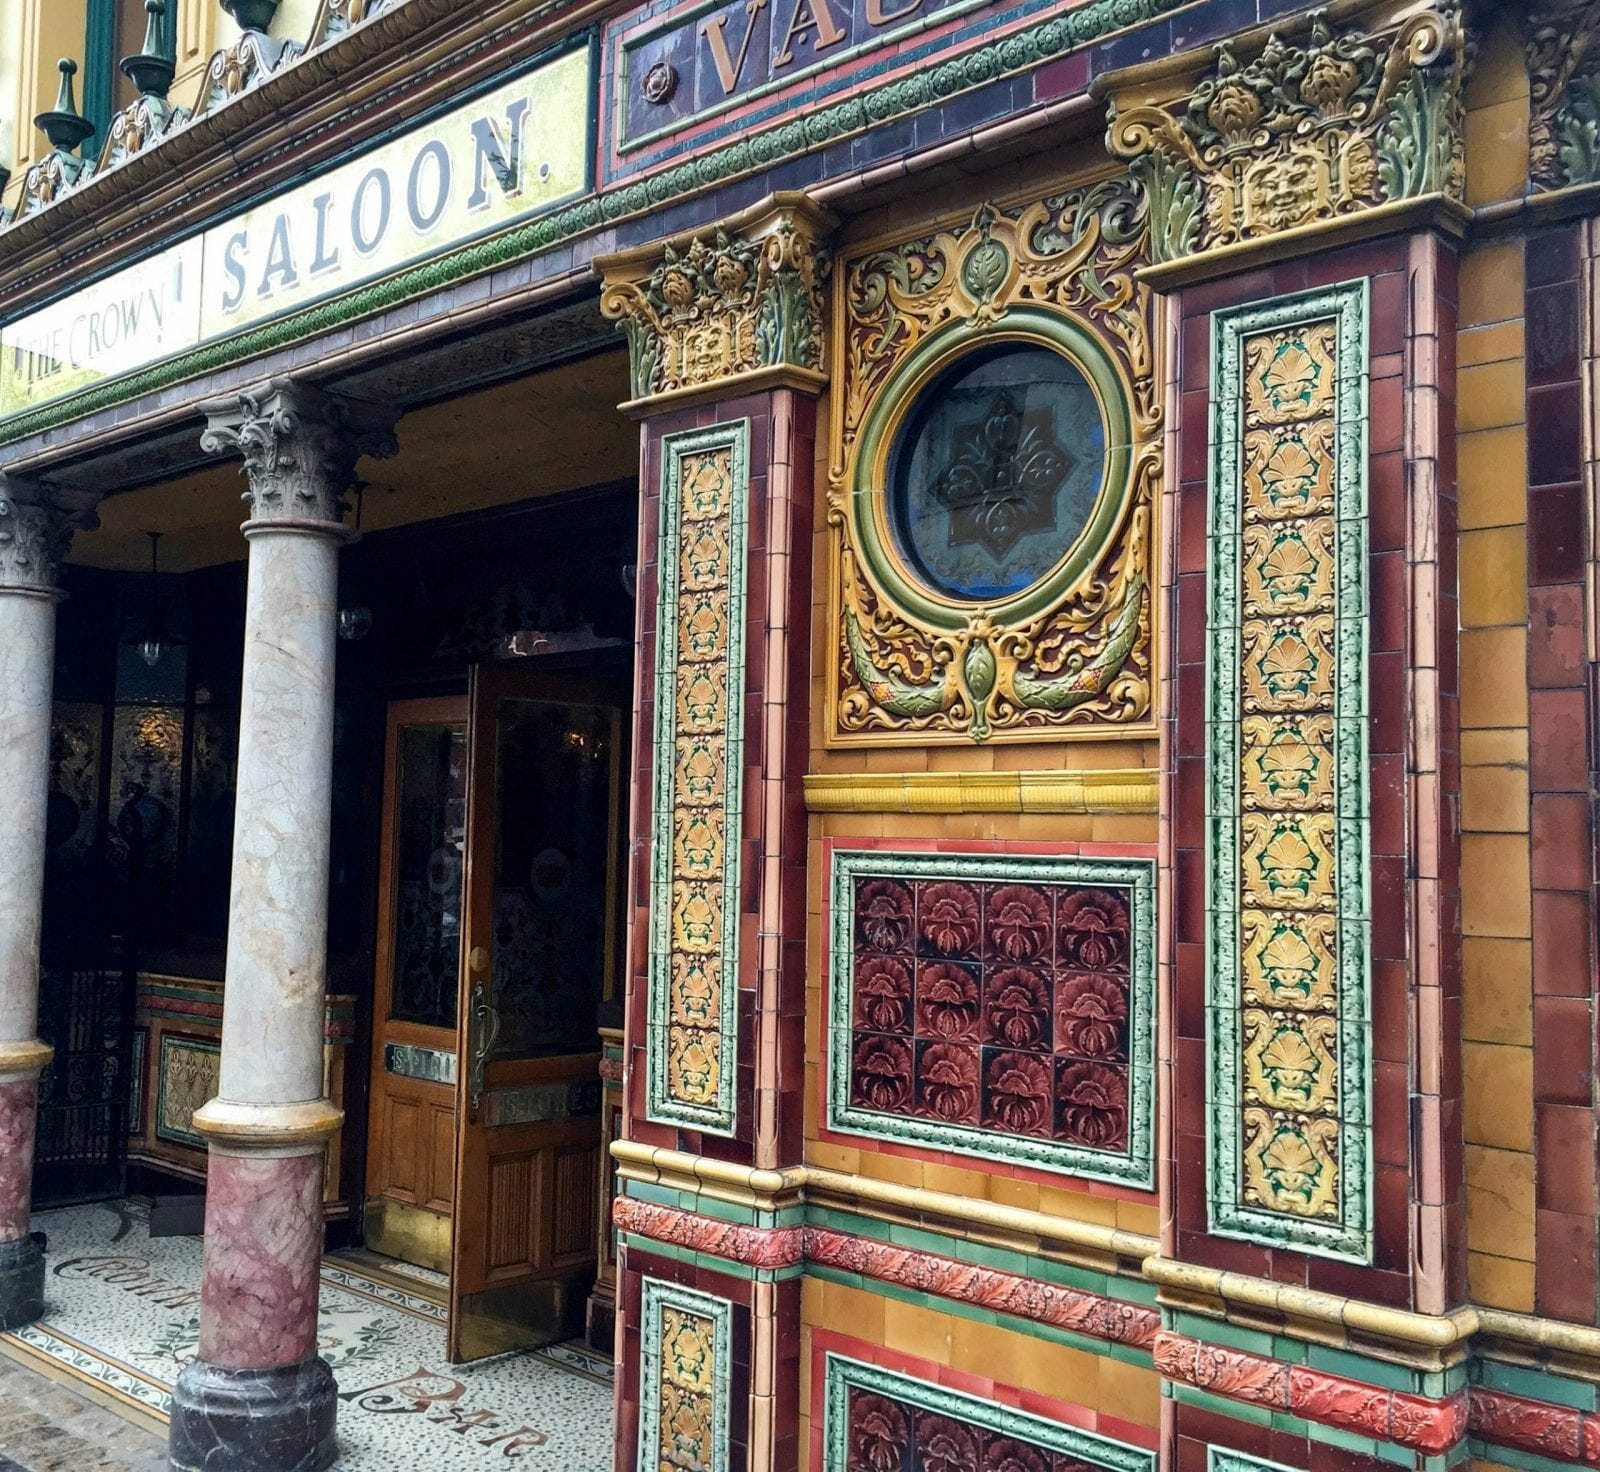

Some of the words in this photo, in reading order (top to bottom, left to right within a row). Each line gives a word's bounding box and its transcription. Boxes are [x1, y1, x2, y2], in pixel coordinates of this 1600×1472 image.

[24, 328, 63, 384] THE
[69, 281, 165, 371] CROWN
[222, 97, 552, 315] SALOON.
[395, 1047, 452, 1080] SPIRI
